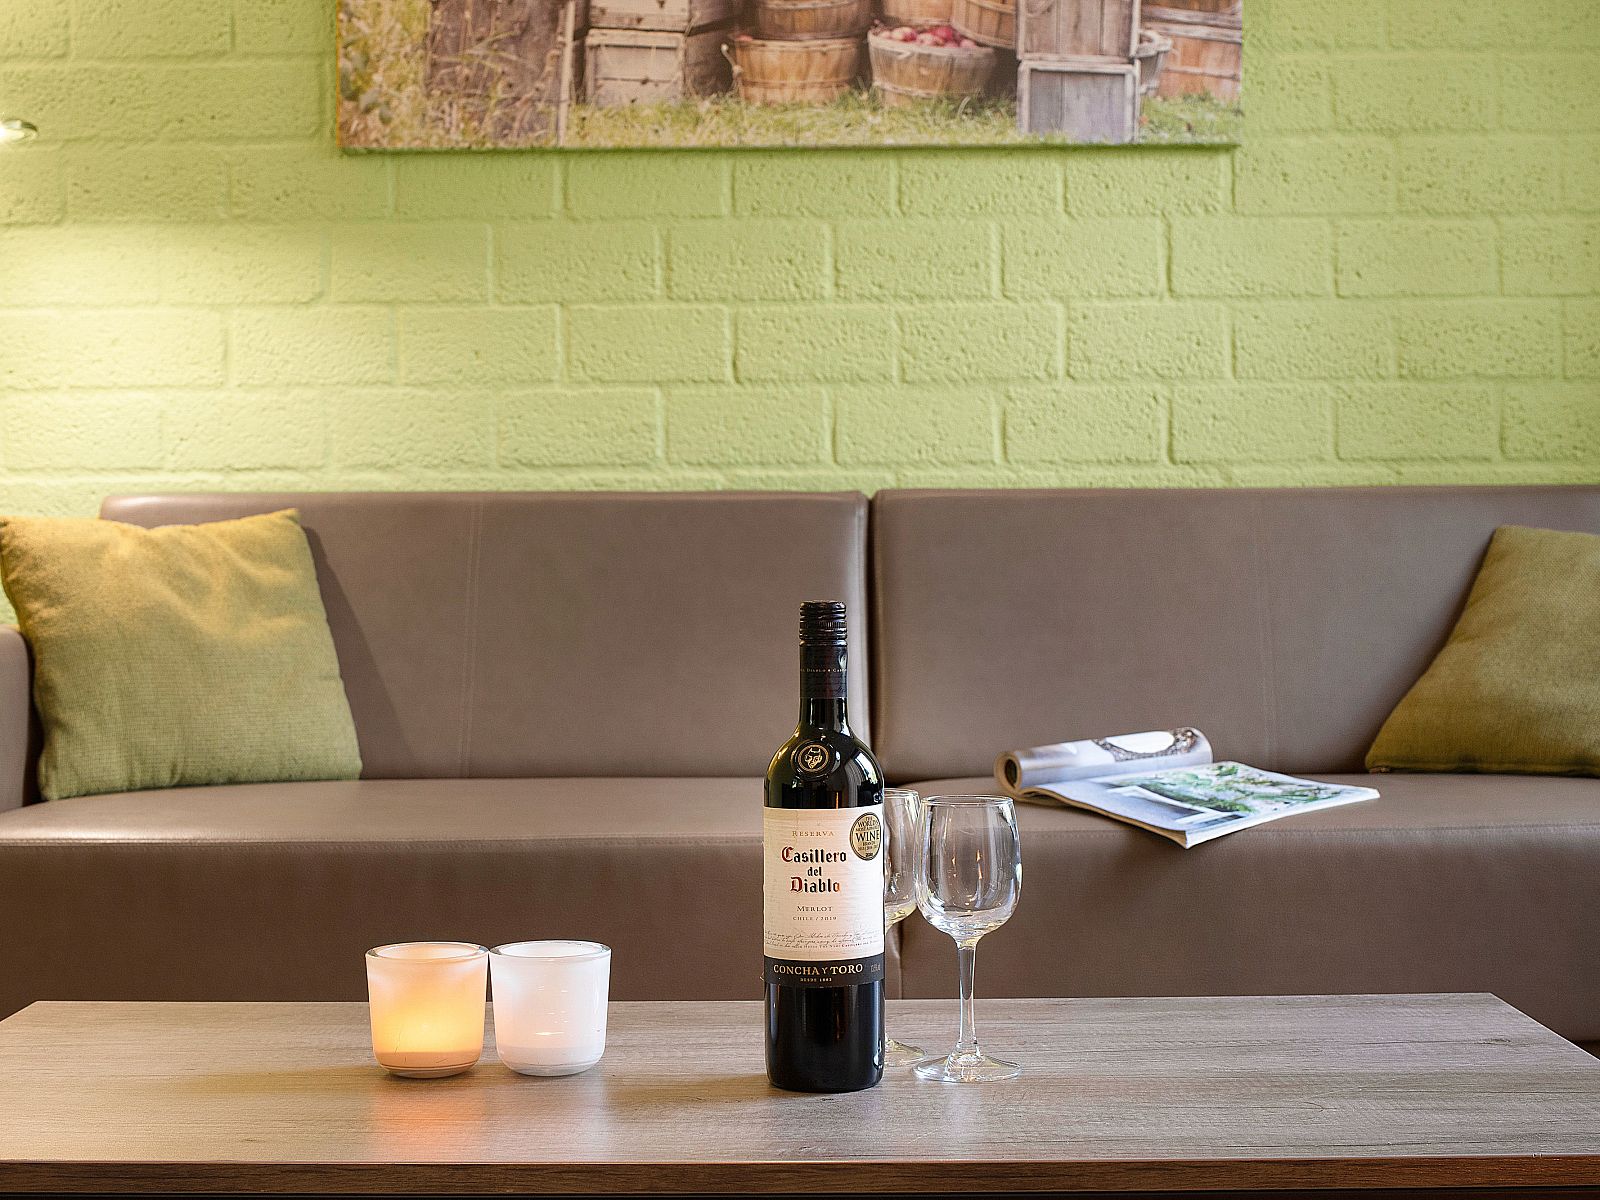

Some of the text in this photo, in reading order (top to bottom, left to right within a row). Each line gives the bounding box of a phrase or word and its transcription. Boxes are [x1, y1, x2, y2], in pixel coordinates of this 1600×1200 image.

[855, 829, 880, 843] WINE
[781, 846, 847, 863] Casillero
[807, 866, 822, 877] del
[790, 876, 840, 893] Diablo
[773, 964, 820, 976] CONCHA
[821, 967, 828, 975] Y
[829, 963, 863, 976] TORO
